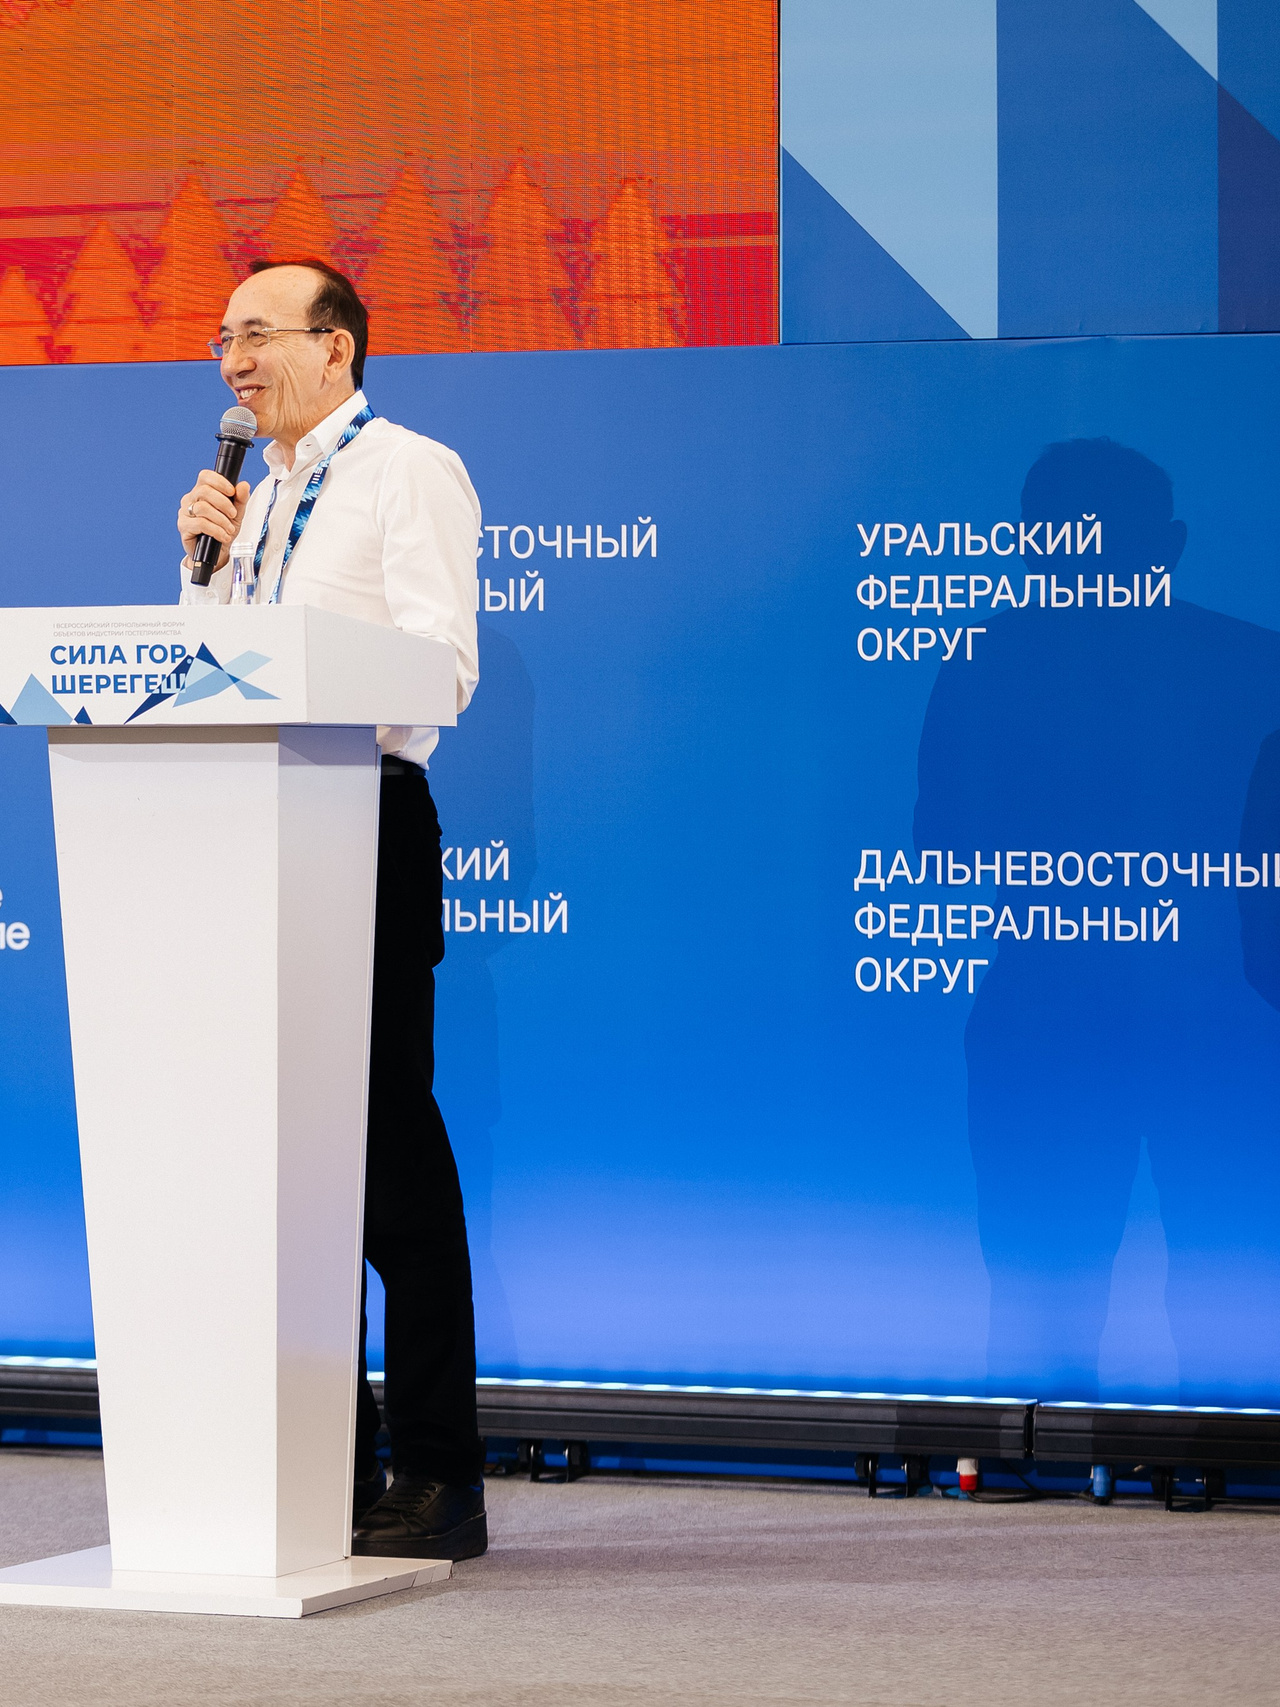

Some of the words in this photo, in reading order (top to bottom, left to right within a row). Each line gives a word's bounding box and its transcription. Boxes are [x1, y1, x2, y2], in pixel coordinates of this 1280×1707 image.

[857, 514, 1102, 557] УРАЛЬСКИЙ
[857, 566, 1171, 617] ФЕДЕРАЛЬНЫЙ
[50, 645, 127, 665] СИЛА
[857, 627, 987, 662] ОКРУГ
[51, 673, 186, 694] ШЕРЕГЕШ
[854, 850, 1280, 892] ДАЛЬНЕВОСТОЧНЫ
[855, 898, 1179, 947] ФЕДЕРАЛЬНЫЙ
[855, 957, 989, 994] ОКРУГ
